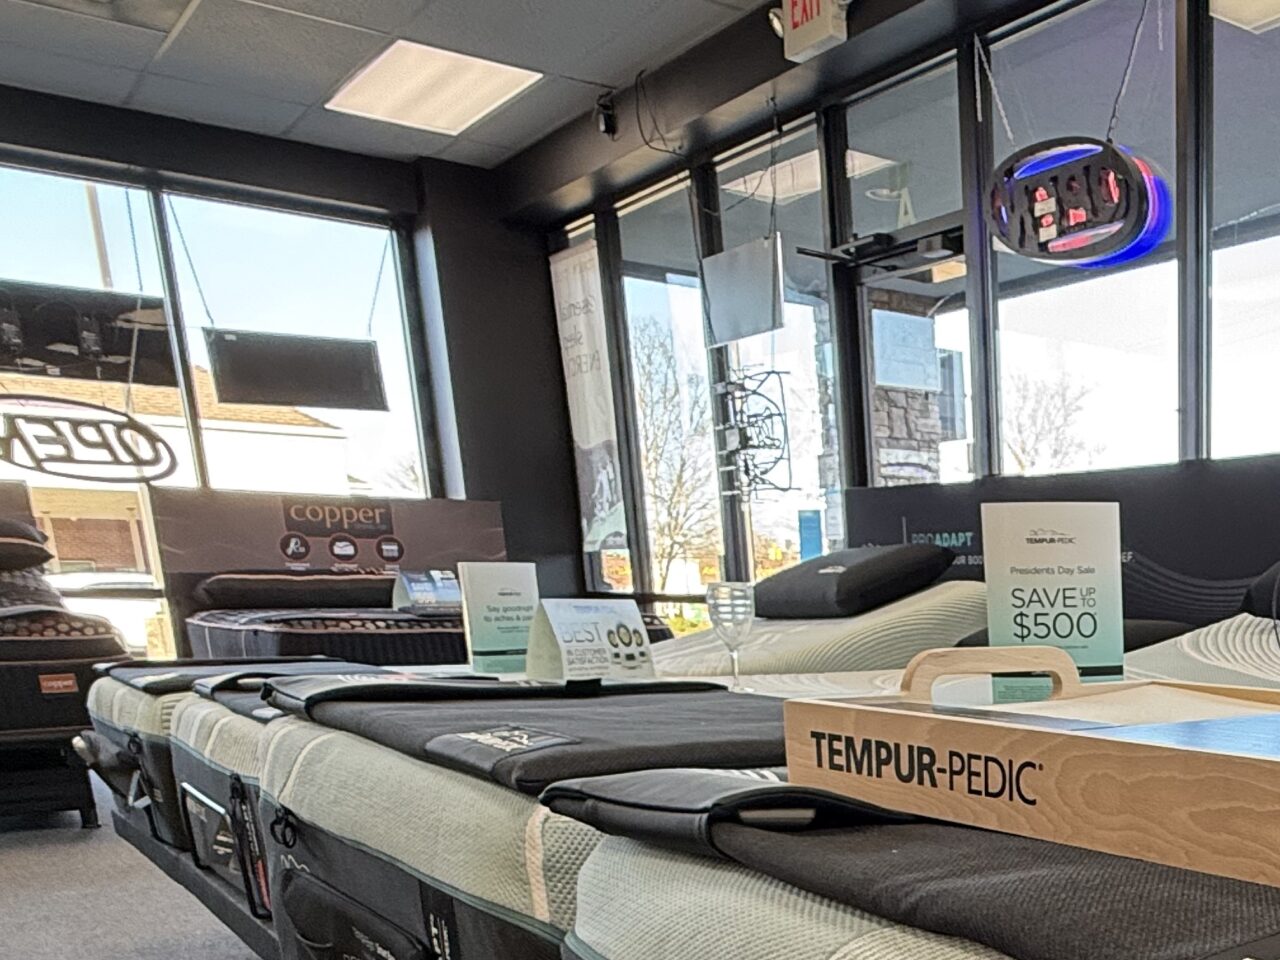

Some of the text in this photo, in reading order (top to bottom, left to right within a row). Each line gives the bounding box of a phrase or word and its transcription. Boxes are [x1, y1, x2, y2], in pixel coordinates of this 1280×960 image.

[289, 504, 387, 529] copper
[1010, 566, 1096, 576] Presidents Day Sale
[1011, 587, 1096, 608] SAVE UP
[1080, 598, 1097, 608] TO
